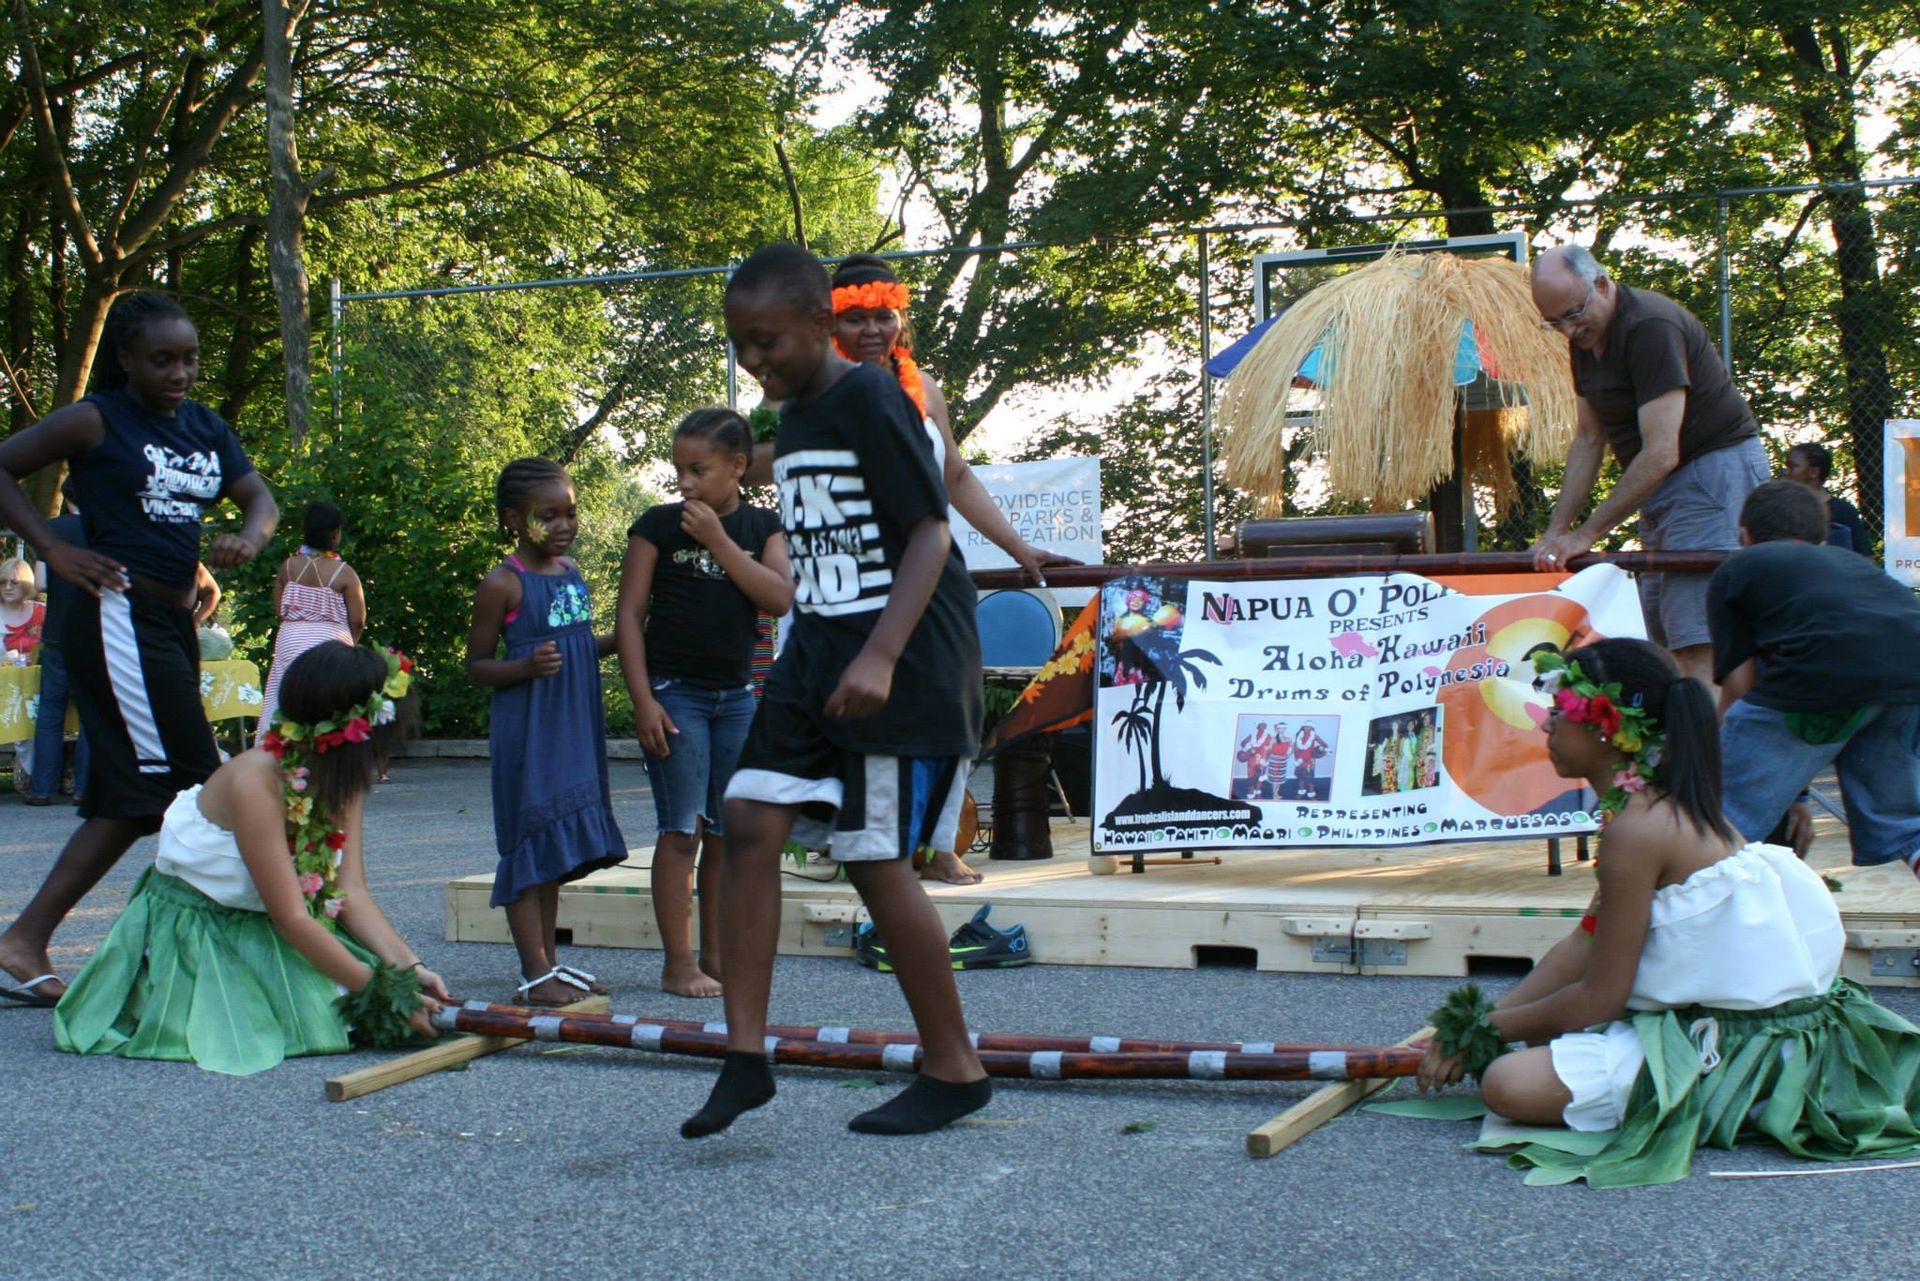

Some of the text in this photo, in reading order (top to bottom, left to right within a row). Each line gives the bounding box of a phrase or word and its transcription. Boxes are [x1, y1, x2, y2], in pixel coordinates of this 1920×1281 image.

[992, 490, 1093, 509] OVIDENCE
[1010, 508, 1094, 525] PARKS &
[968, 525, 1094, 545] REEATION
[1201, 591, 1314, 621] NAPUA
[1328, 587, 1365, 617] O'
[1329, 606, 1429, 634] PRESENTS
[1262, 623, 1486, 671] Aloha Hawaii
[1229, 657, 1511, 701] Drums of Polynesia
[1114, 809, 1251, 826] www.tropicalislanddancers.com
[1296, 803, 1428, 820] REPRESENTING
[1103, 813, 1571, 846] HAWAII TAHITI MAORI PHILIPPINES MARQUESAS
